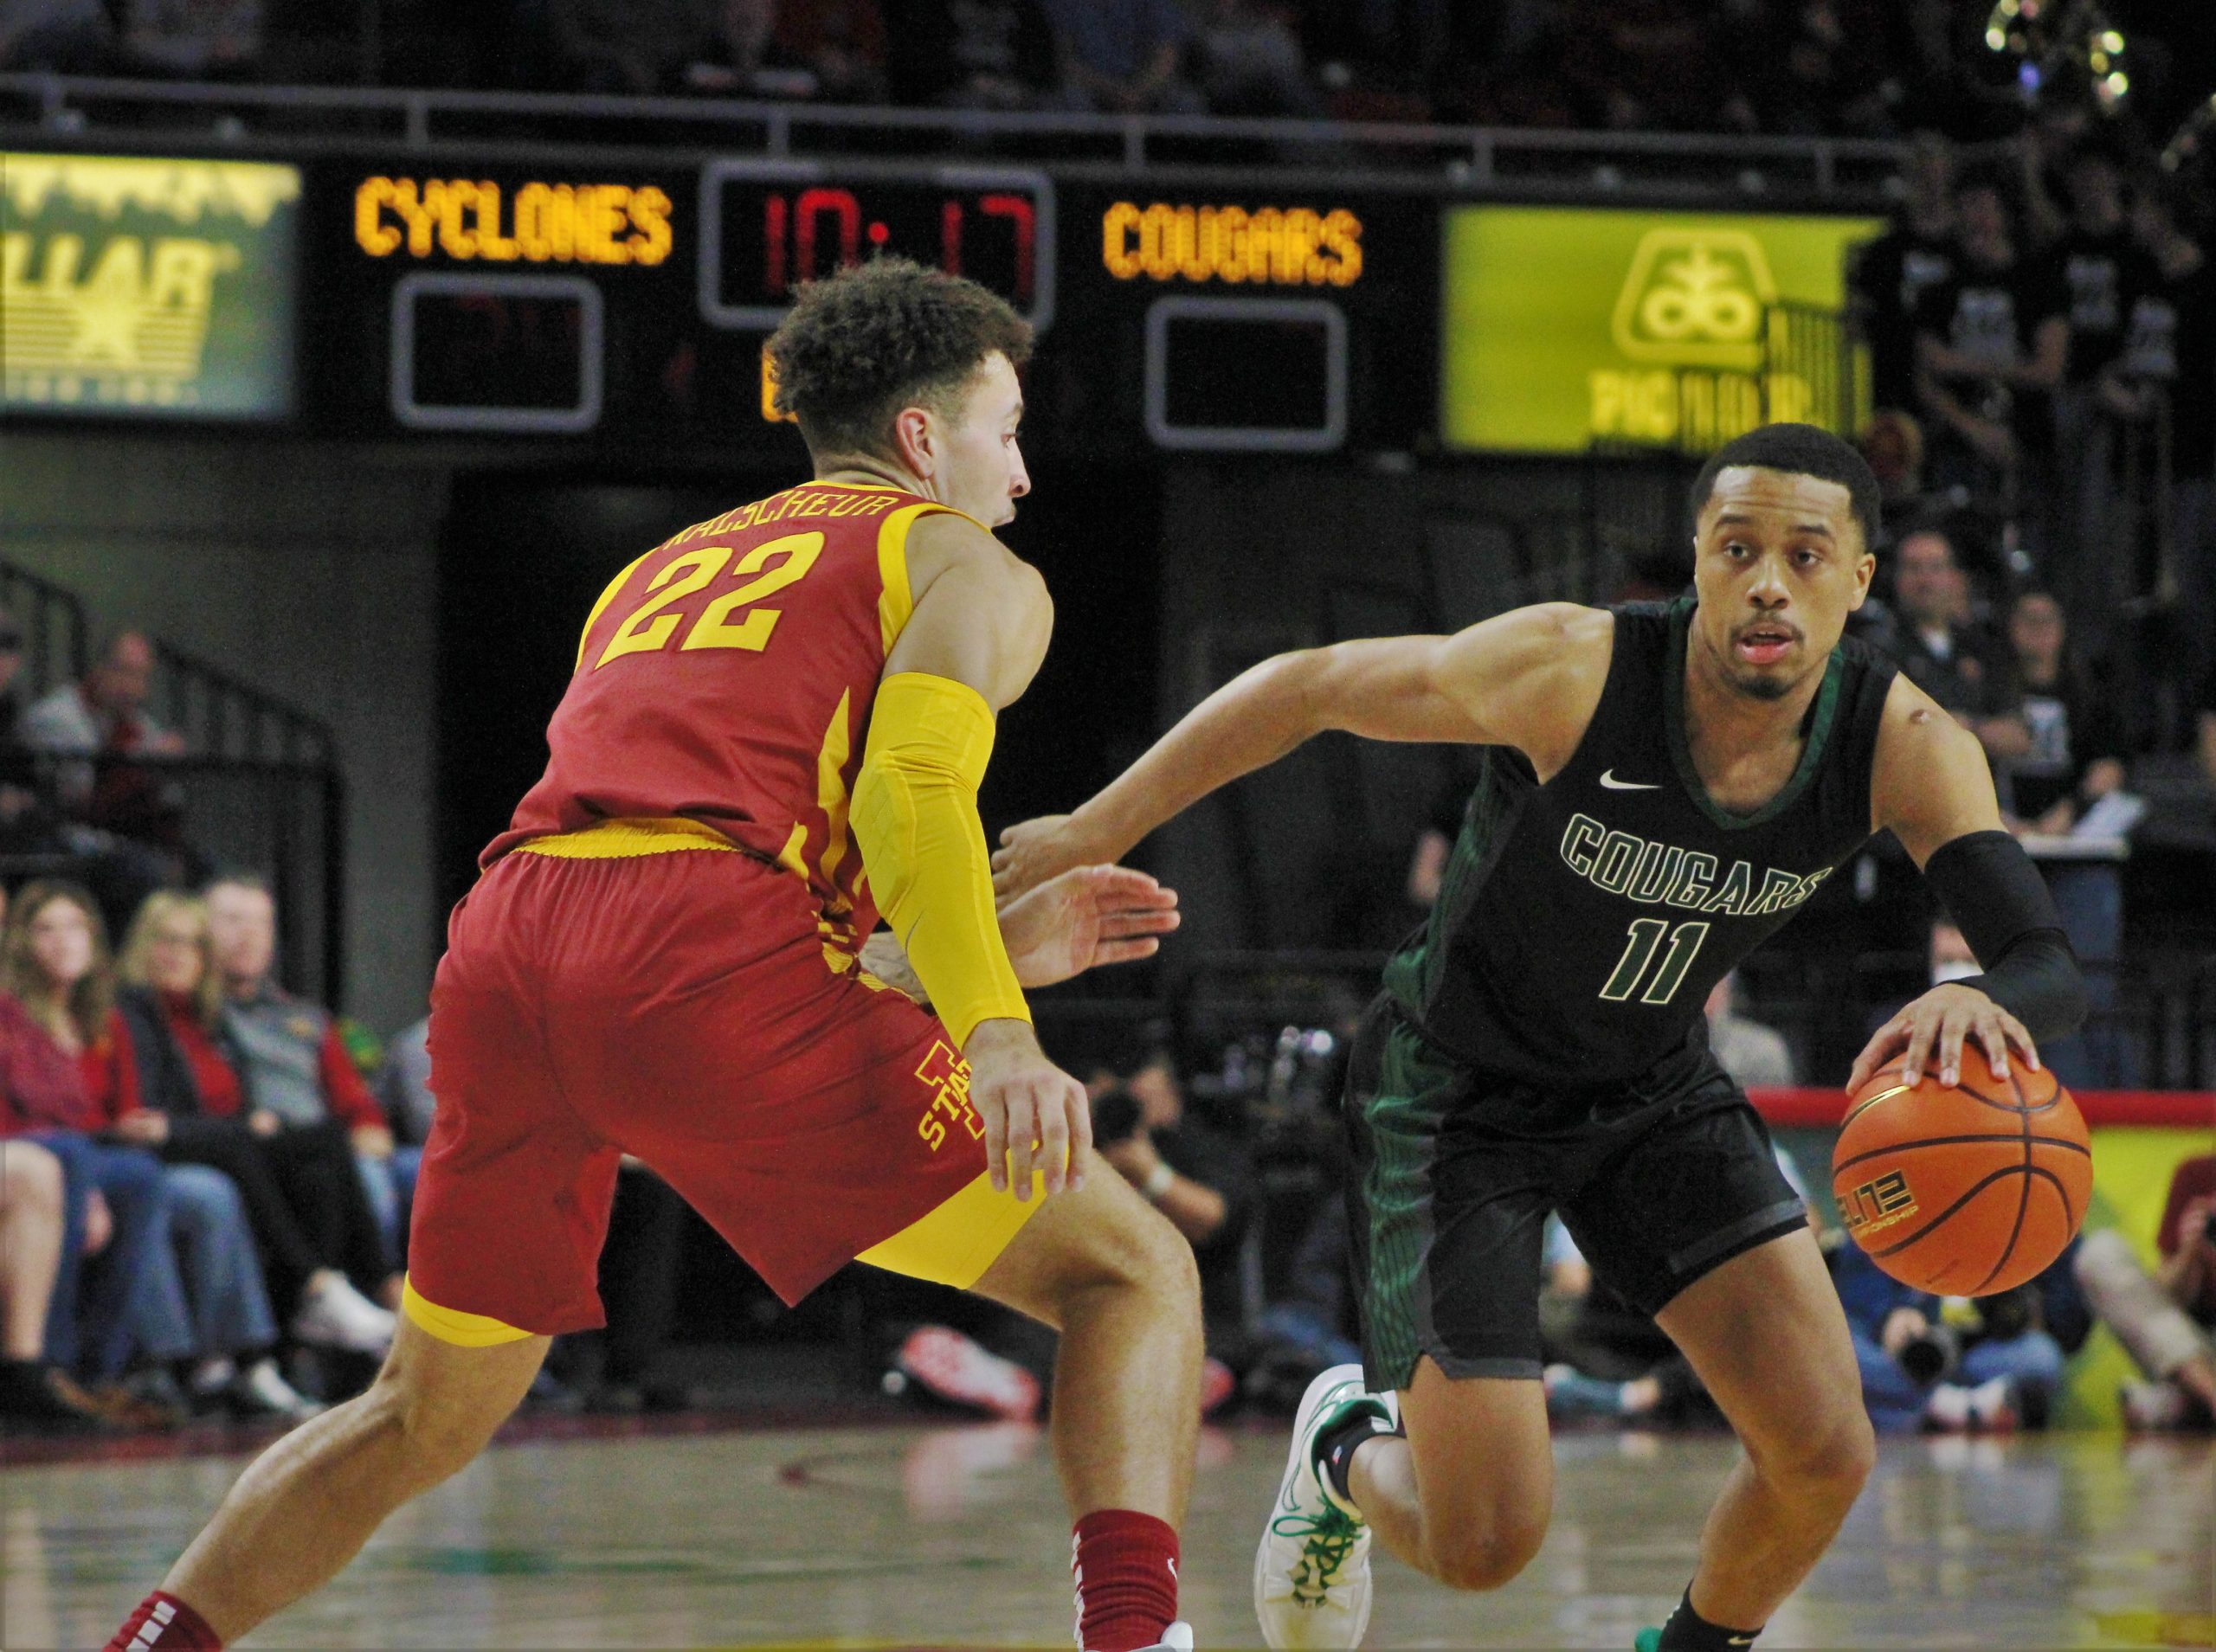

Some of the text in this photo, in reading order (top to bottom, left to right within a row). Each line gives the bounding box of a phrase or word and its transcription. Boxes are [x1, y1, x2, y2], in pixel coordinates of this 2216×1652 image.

[355, 176, 673, 265] CYCLONES
[1103, 201, 1363, 287] COUGARS
[594, 530, 825, 670] 22
[1560, 813, 1833, 916] COUGARS
[1598, 917, 1710, 1005] 11
